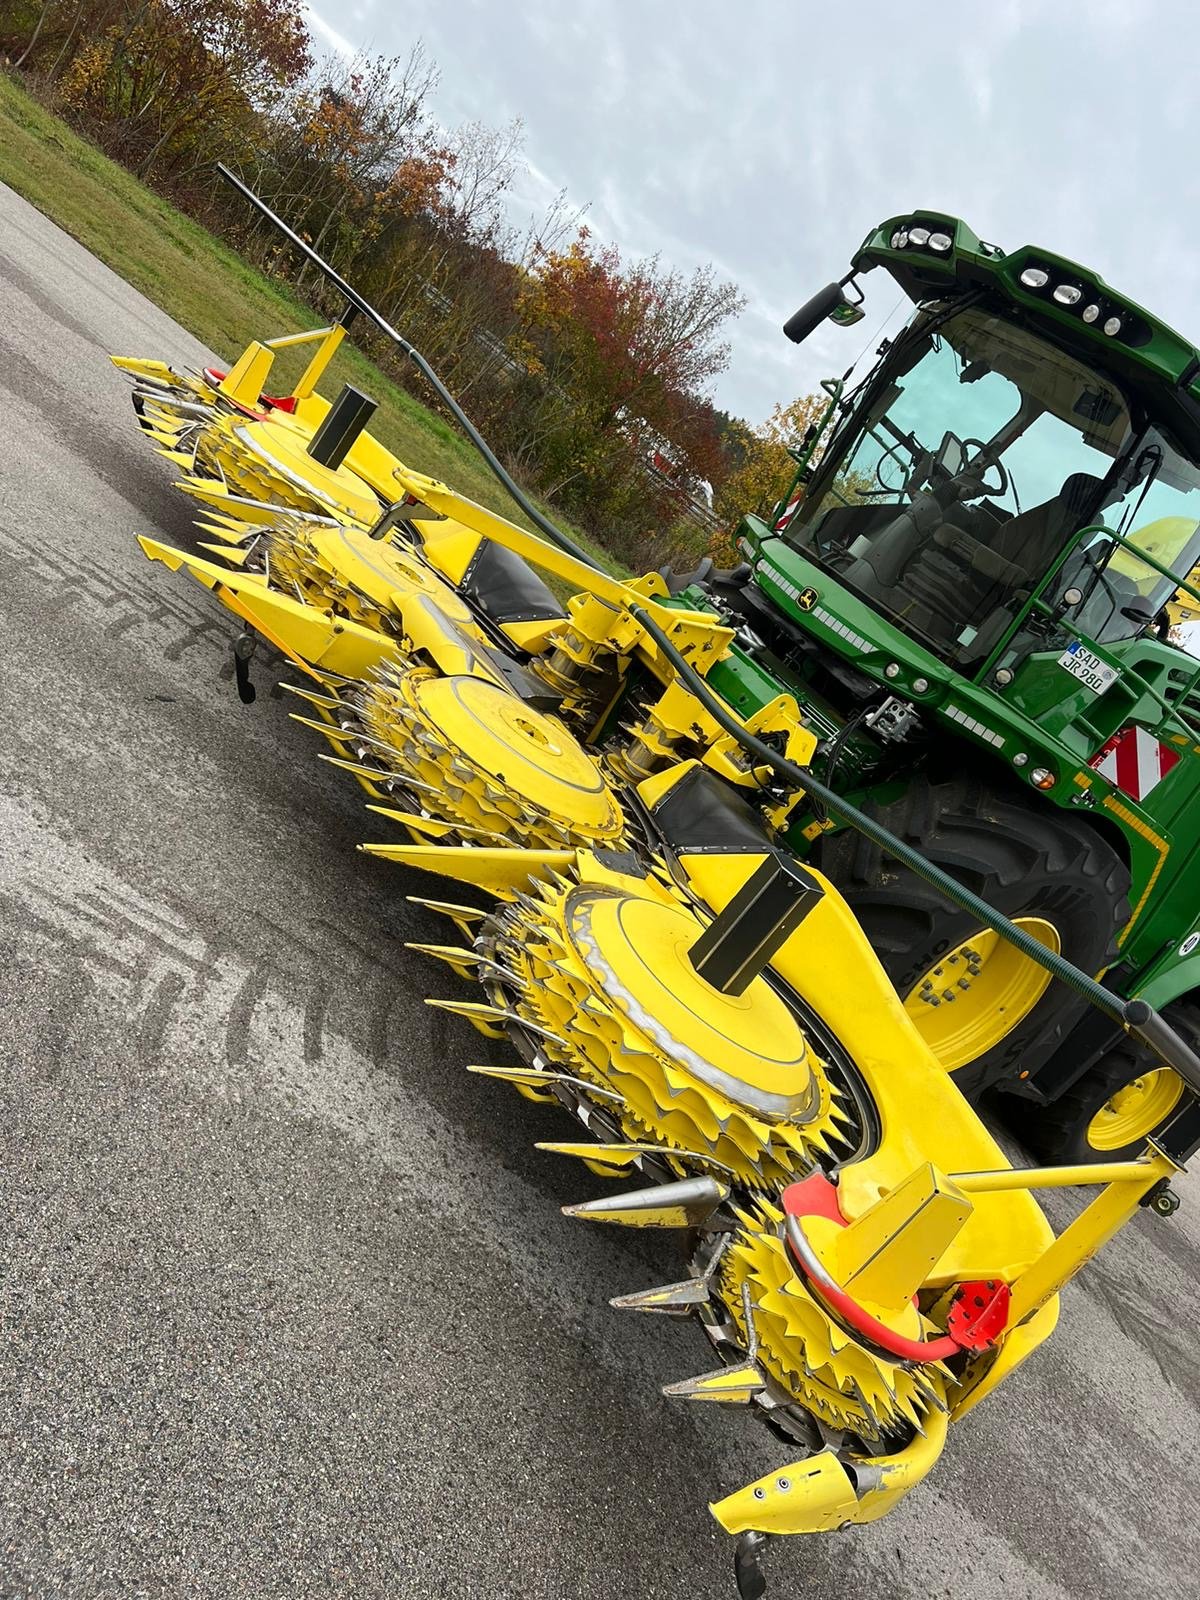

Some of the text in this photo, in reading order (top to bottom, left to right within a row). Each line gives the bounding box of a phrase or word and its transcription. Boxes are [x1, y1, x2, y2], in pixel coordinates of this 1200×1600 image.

[1075, 648, 1101, 670] SAD
[1063, 657, 1104, 690] JR 980
